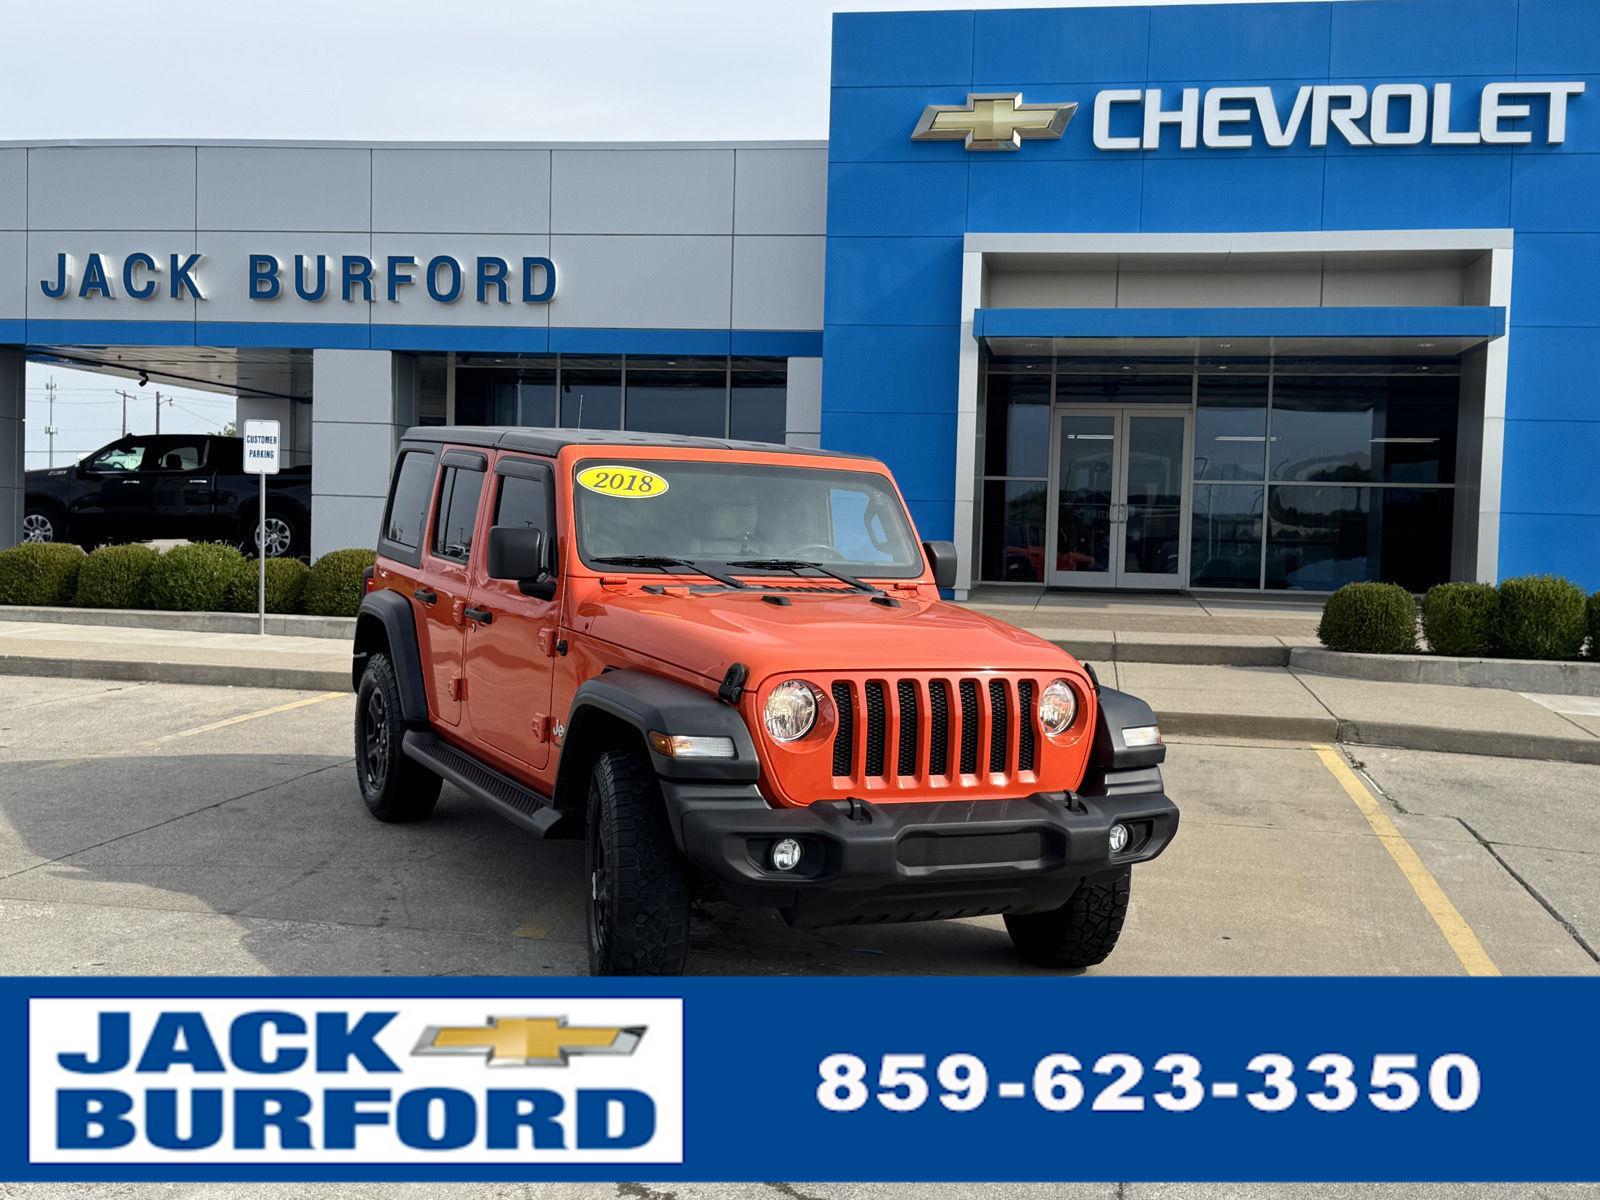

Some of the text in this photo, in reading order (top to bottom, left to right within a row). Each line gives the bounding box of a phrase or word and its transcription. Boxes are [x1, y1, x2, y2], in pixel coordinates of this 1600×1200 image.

[1092, 81, 1585, 150] CHEVROLET
[41, 253, 558, 303] JACK BURFORD
[246, 434, 278, 444] CUSTOMER
[249, 449, 275, 459] PARKING
[593, 472, 653, 492] 2018
